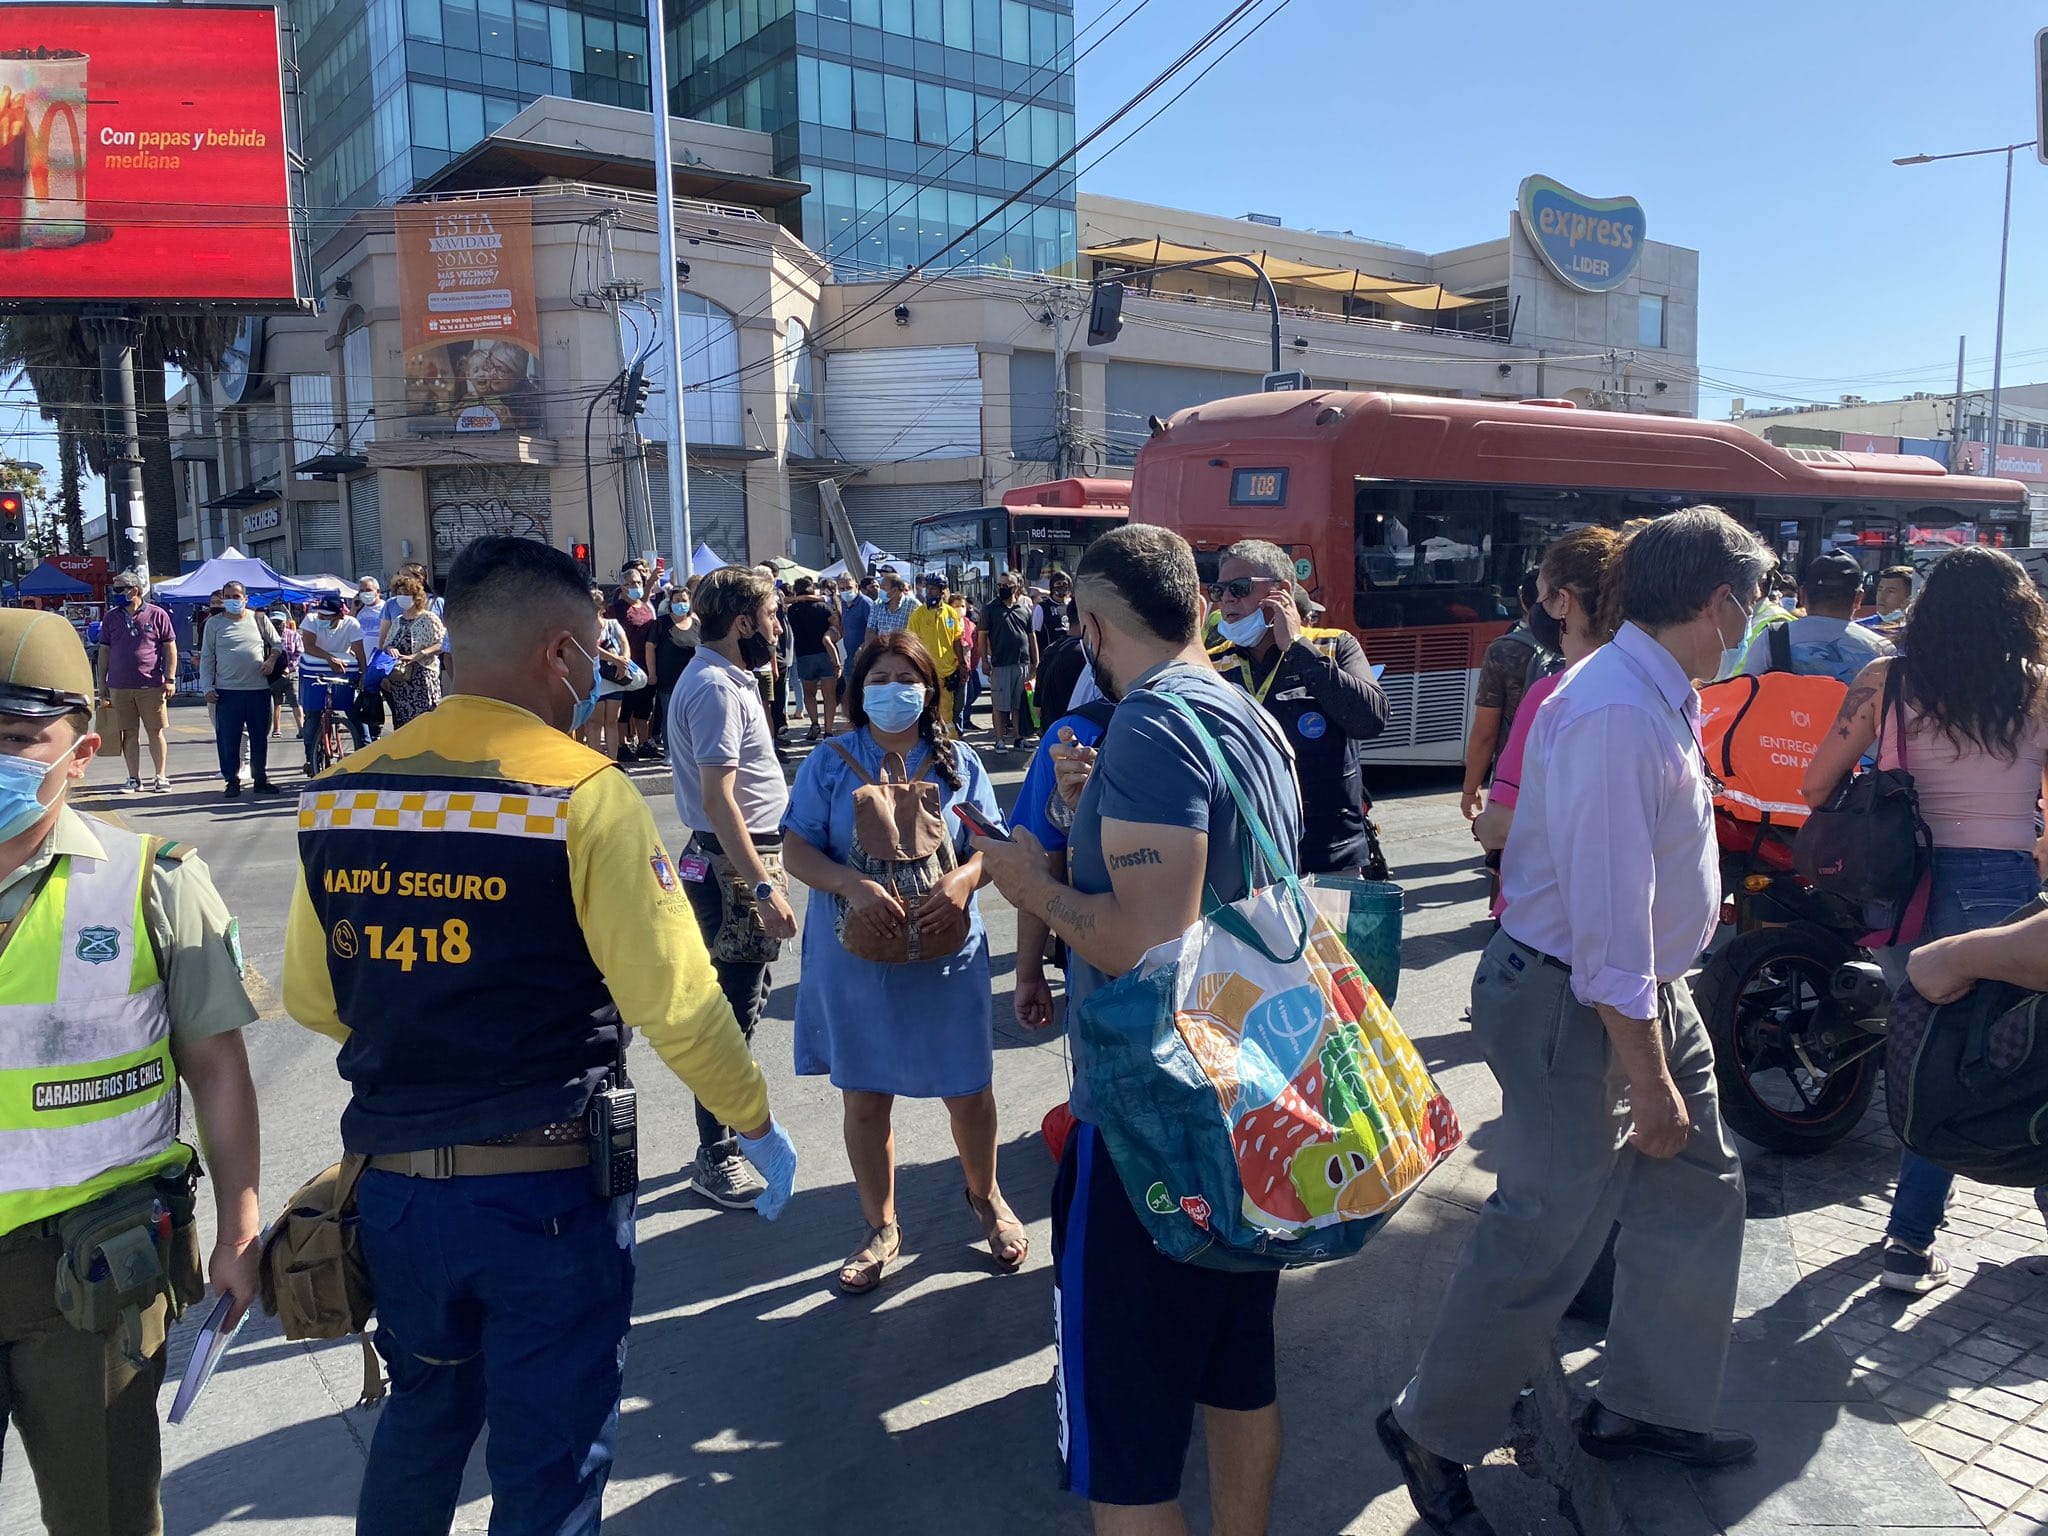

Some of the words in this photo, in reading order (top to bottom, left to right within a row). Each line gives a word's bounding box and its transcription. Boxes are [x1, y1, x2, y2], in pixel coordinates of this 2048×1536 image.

[100, 127, 135, 146] Con
[138, 131, 191, 150] papas
[192, 132, 204, 151] y
[207, 128, 266, 147] bebida
[105, 151, 181, 169] mediana
[433, 213, 496, 237] ESTA
[1539, 207, 1634, 249] express
[435, 236, 497, 250] NAVIDAD
[437, 249, 498, 267] SOMOS
[1572, 255, 1610, 277] LIDER
[456, 269, 494, 279] VECINOS
[438, 279, 457, 291] que
[1031, 526, 1047, 538] Red
[59, 560, 89, 569] Claro
[1771, 752, 1799, 768] CON
[1109, 847, 1163, 871] CrossFit
[397, 871, 507, 901] SEGURO
[364, 918, 472, 972] 1418
[35, 1074, 123, 1107] CARABINEROS
[125, 1070, 138, 1092] DE
[139, 1061, 163, 1087] CHILE
